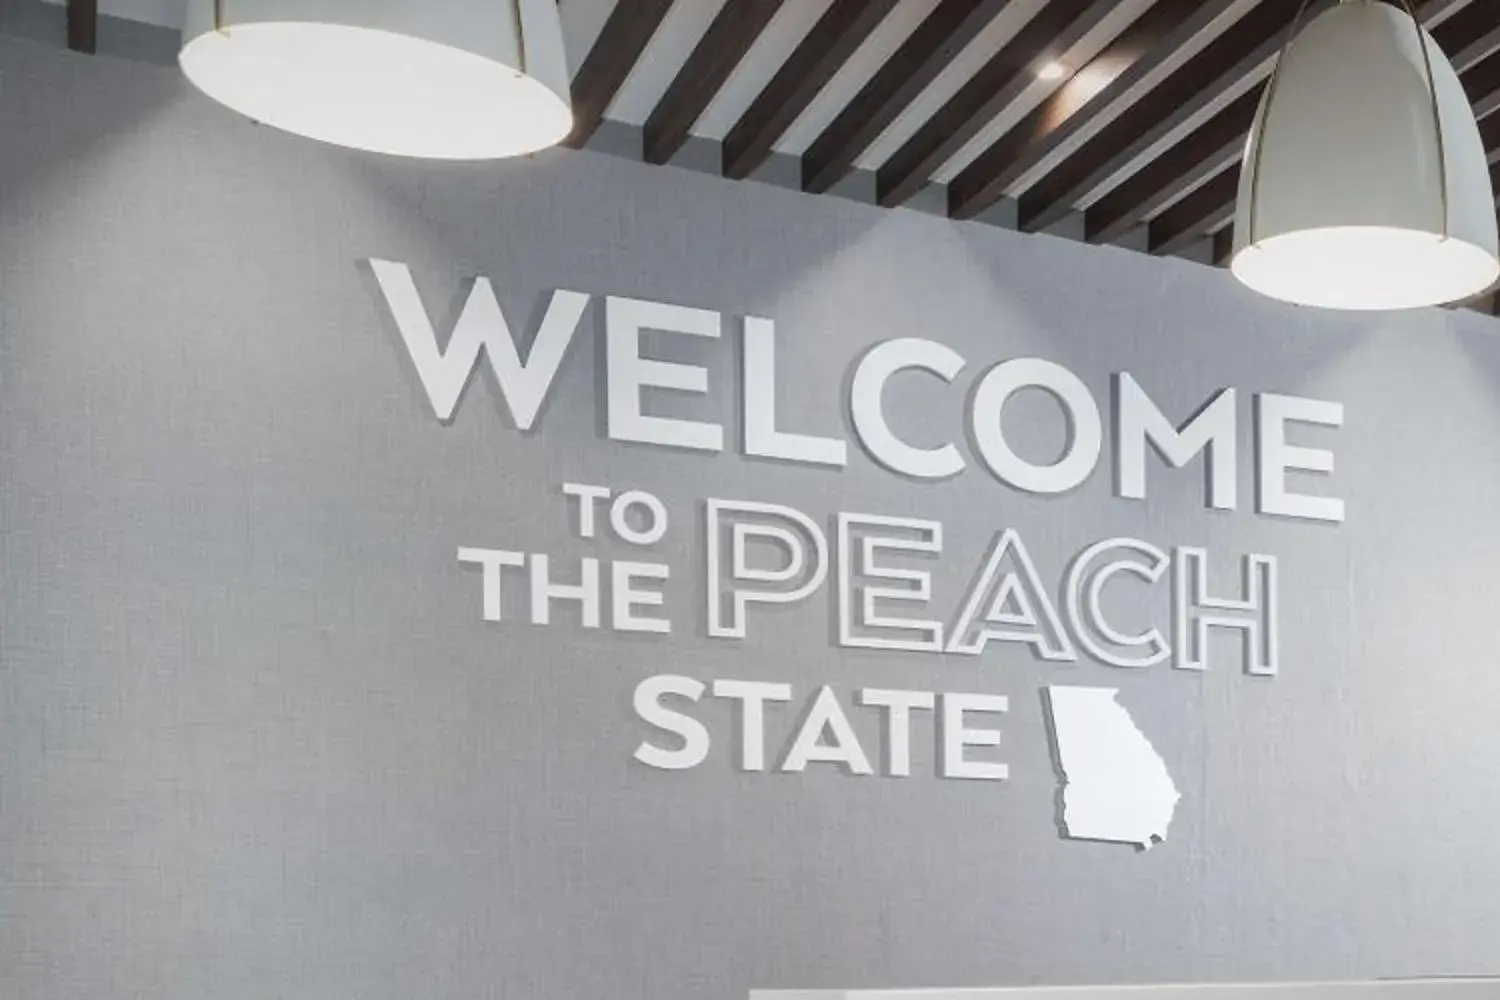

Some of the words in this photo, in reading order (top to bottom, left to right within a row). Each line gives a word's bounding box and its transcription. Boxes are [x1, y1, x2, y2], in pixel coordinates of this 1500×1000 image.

[370, 257, 1345, 522] WELCOME
[562, 482, 669, 545] TO
[457, 545, 671, 633] THE
[706, 497, 1278, 676] PEACH
[632, 674, 1008, 779] STATE
